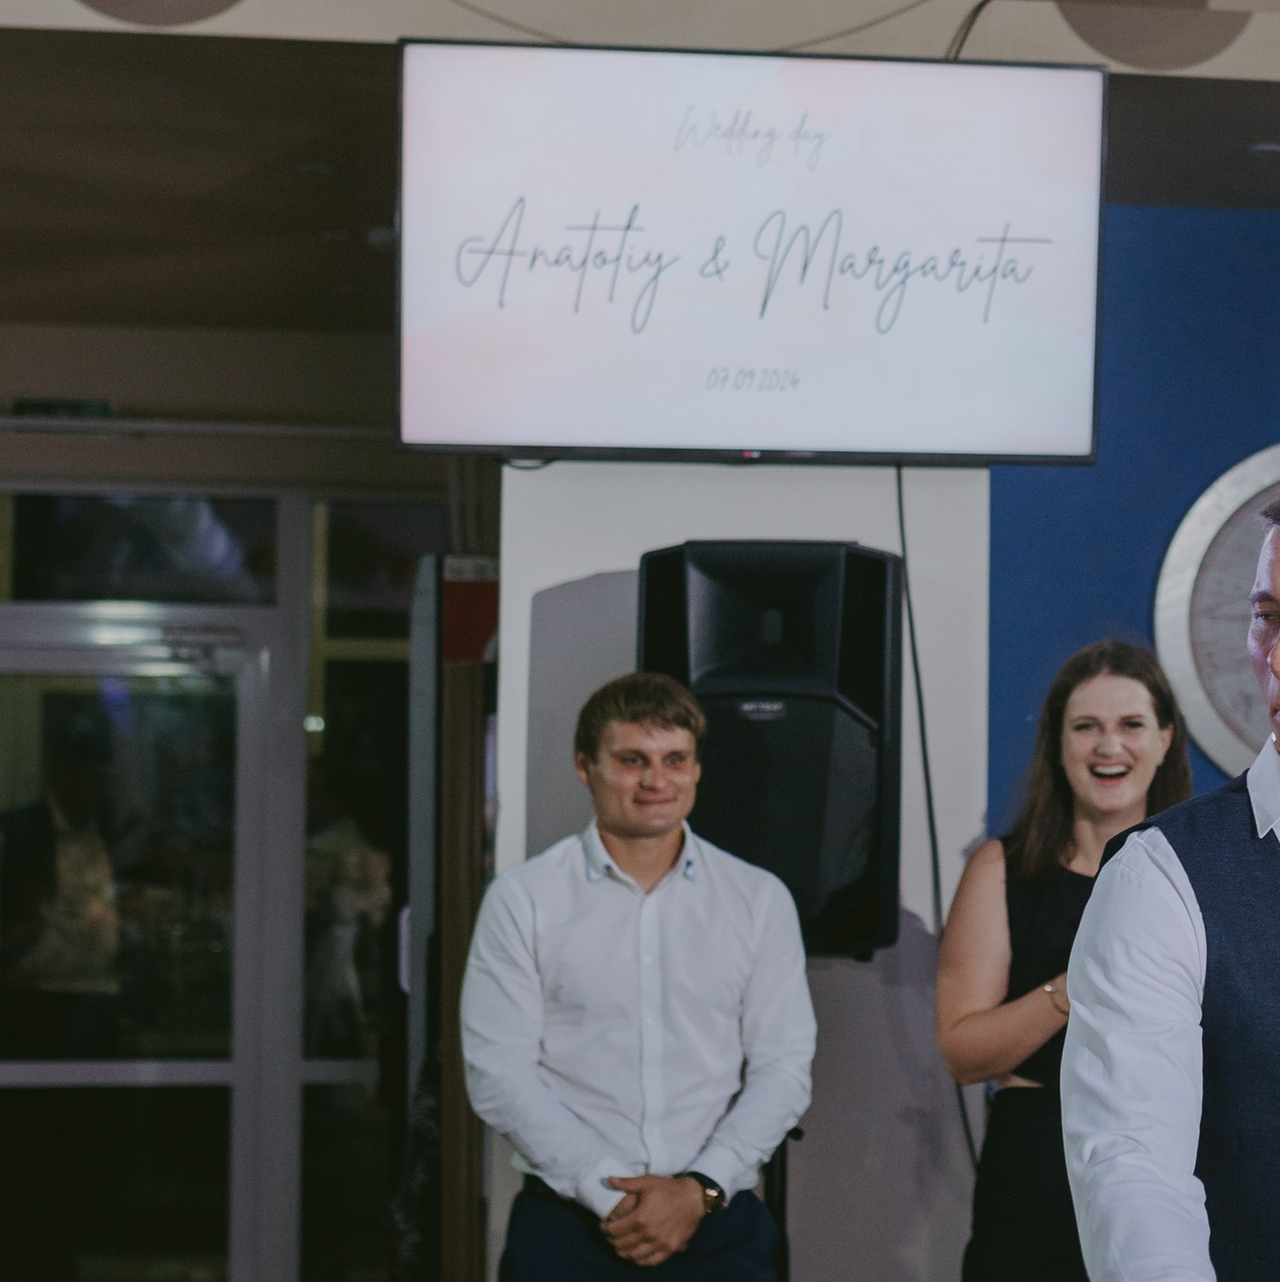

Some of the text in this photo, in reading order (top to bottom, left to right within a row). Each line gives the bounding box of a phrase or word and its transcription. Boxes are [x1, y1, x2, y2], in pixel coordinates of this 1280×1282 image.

[672, 101, 832, 174] Wedding day
[698, 234, 731, 281] &
[753, 208, 1054, 335] Margarita
